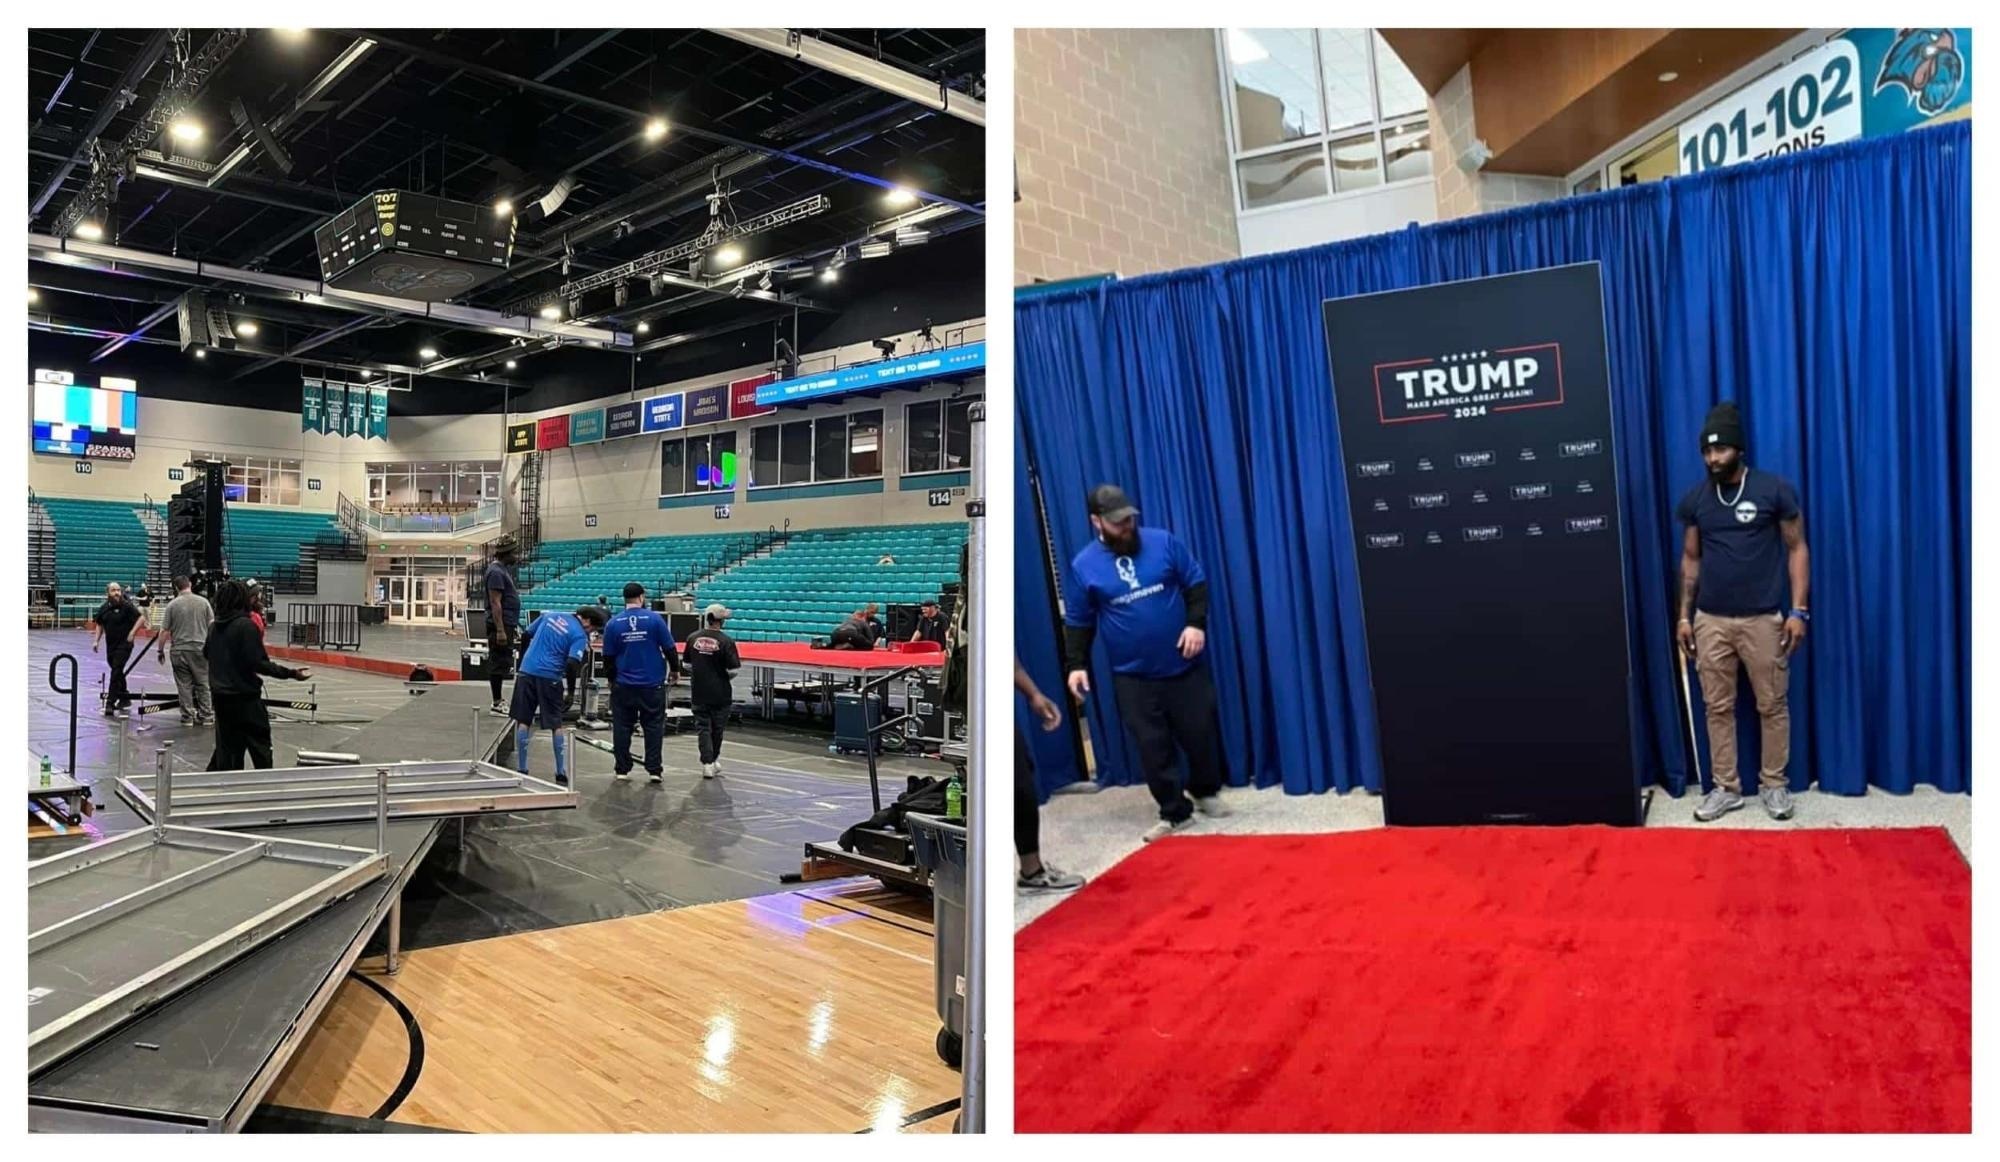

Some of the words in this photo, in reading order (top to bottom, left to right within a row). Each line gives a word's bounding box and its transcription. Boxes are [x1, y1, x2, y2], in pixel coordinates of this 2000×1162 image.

[1683, 55, 1853, 174] 101-102
[375, 193, 397, 203] 707
[1395, 357, 1539, 399] TRUMP
[1406, 401, 1430, 409] MAKE
[1432, 396, 1470, 407] AMERICA
[1472, 393, 1500, 402] GREAT
[1502, 389, 1534, 399] AGAIN!
[1454, 406, 1487, 418] 2024
[1565, 442, 1597, 454] TRUMP
[1460, 453, 1490, 464] TRUMP
[76, 463, 91, 472] 110
[1361, 463, 1390, 473] TRUMP
[171, 470, 182, 479] 111
[310, 481, 320, 489] 111
[1515, 486, 1546, 496] TRUMP
[930, 492, 950, 504] 114
[1414, 495, 1443, 506] TRUMP
[715, 507, 729, 517] 113
[1571, 518, 1602, 530] TRUMP
[1468, 528, 1498, 539] TRUMP
[1371, 535, 1399, 545] TRUMP
